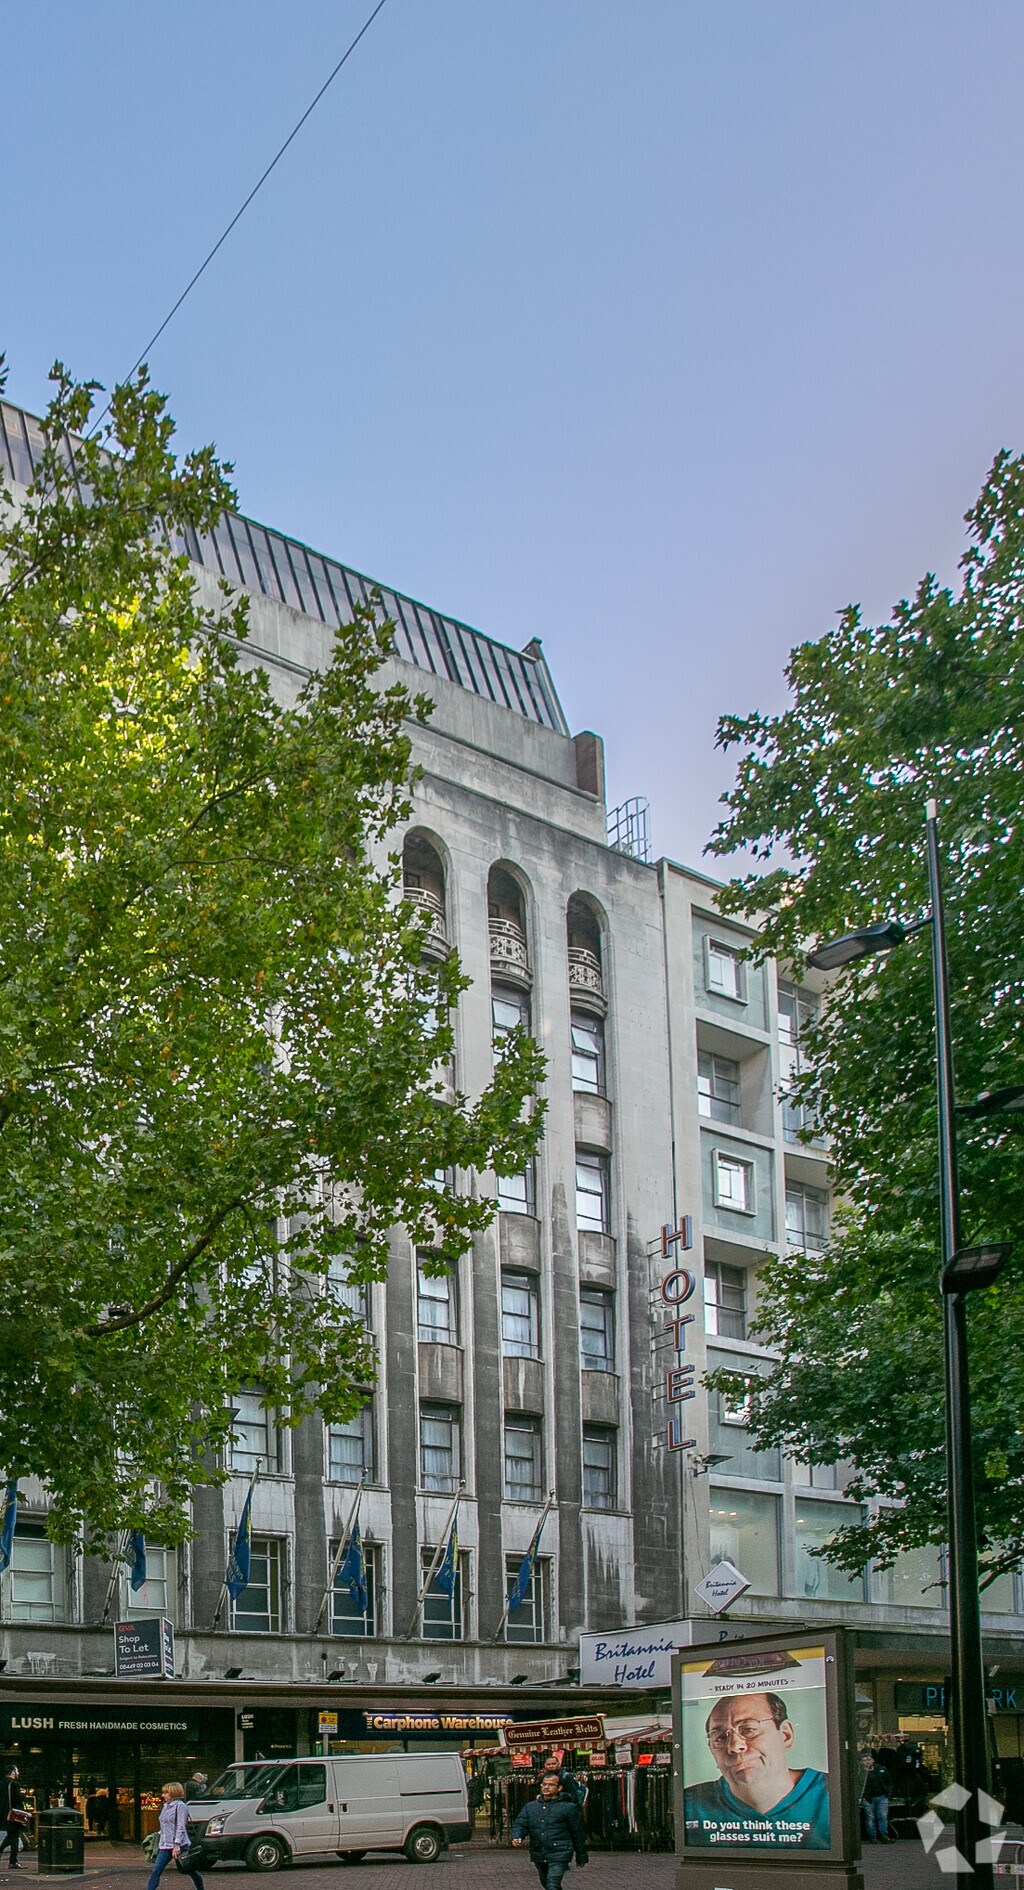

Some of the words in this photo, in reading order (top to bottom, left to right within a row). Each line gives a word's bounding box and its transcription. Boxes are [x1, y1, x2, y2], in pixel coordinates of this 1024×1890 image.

[660, 1215, 696, 1452] HOTEL
[705, 1580, 737, 1589] Britannia
[712, 1588, 729, 1597] Hotel
[118, 1624, 135, 1632] GVA
[118, 1635, 140, 1644] Shop
[119, 1645, 131, 1654] To
[132, 1643, 149, 1653] Let
[595, 1638, 677, 1661] Britannia
[614, 1660, 656, 1683] Hotel
[714, 1684, 735, 1692] READY
[746, 1681, 756, 1689] 20
[757, 1679, 788, 1688] MINUTES
[11, 1717, 54, 1729] LUSH
[58, 1721, 88, 1730] FRESH
[89, 1722, 138, 1730] HANDMADE
[139, 1722, 188, 1731] COSMETICS
[374, 1716, 439, 1731] Carphone
[440, 1716, 514, 1730] Warehouse
[508, 1729, 541, 1740] Genuine
[541, 1726, 573, 1739] Leather
[575, 1724, 599, 1734] Belts
[703, 1820, 717, 1830] Do
[720, 1821, 740, 1832] you
[742, 1820, 773, 1830] think
[775, 1820, 811, 1831] these
[709, 1832, 750, 1843] glasses
[752, 1832, 776, 1842] suit
[778, 1832, 804, 1843] me?
